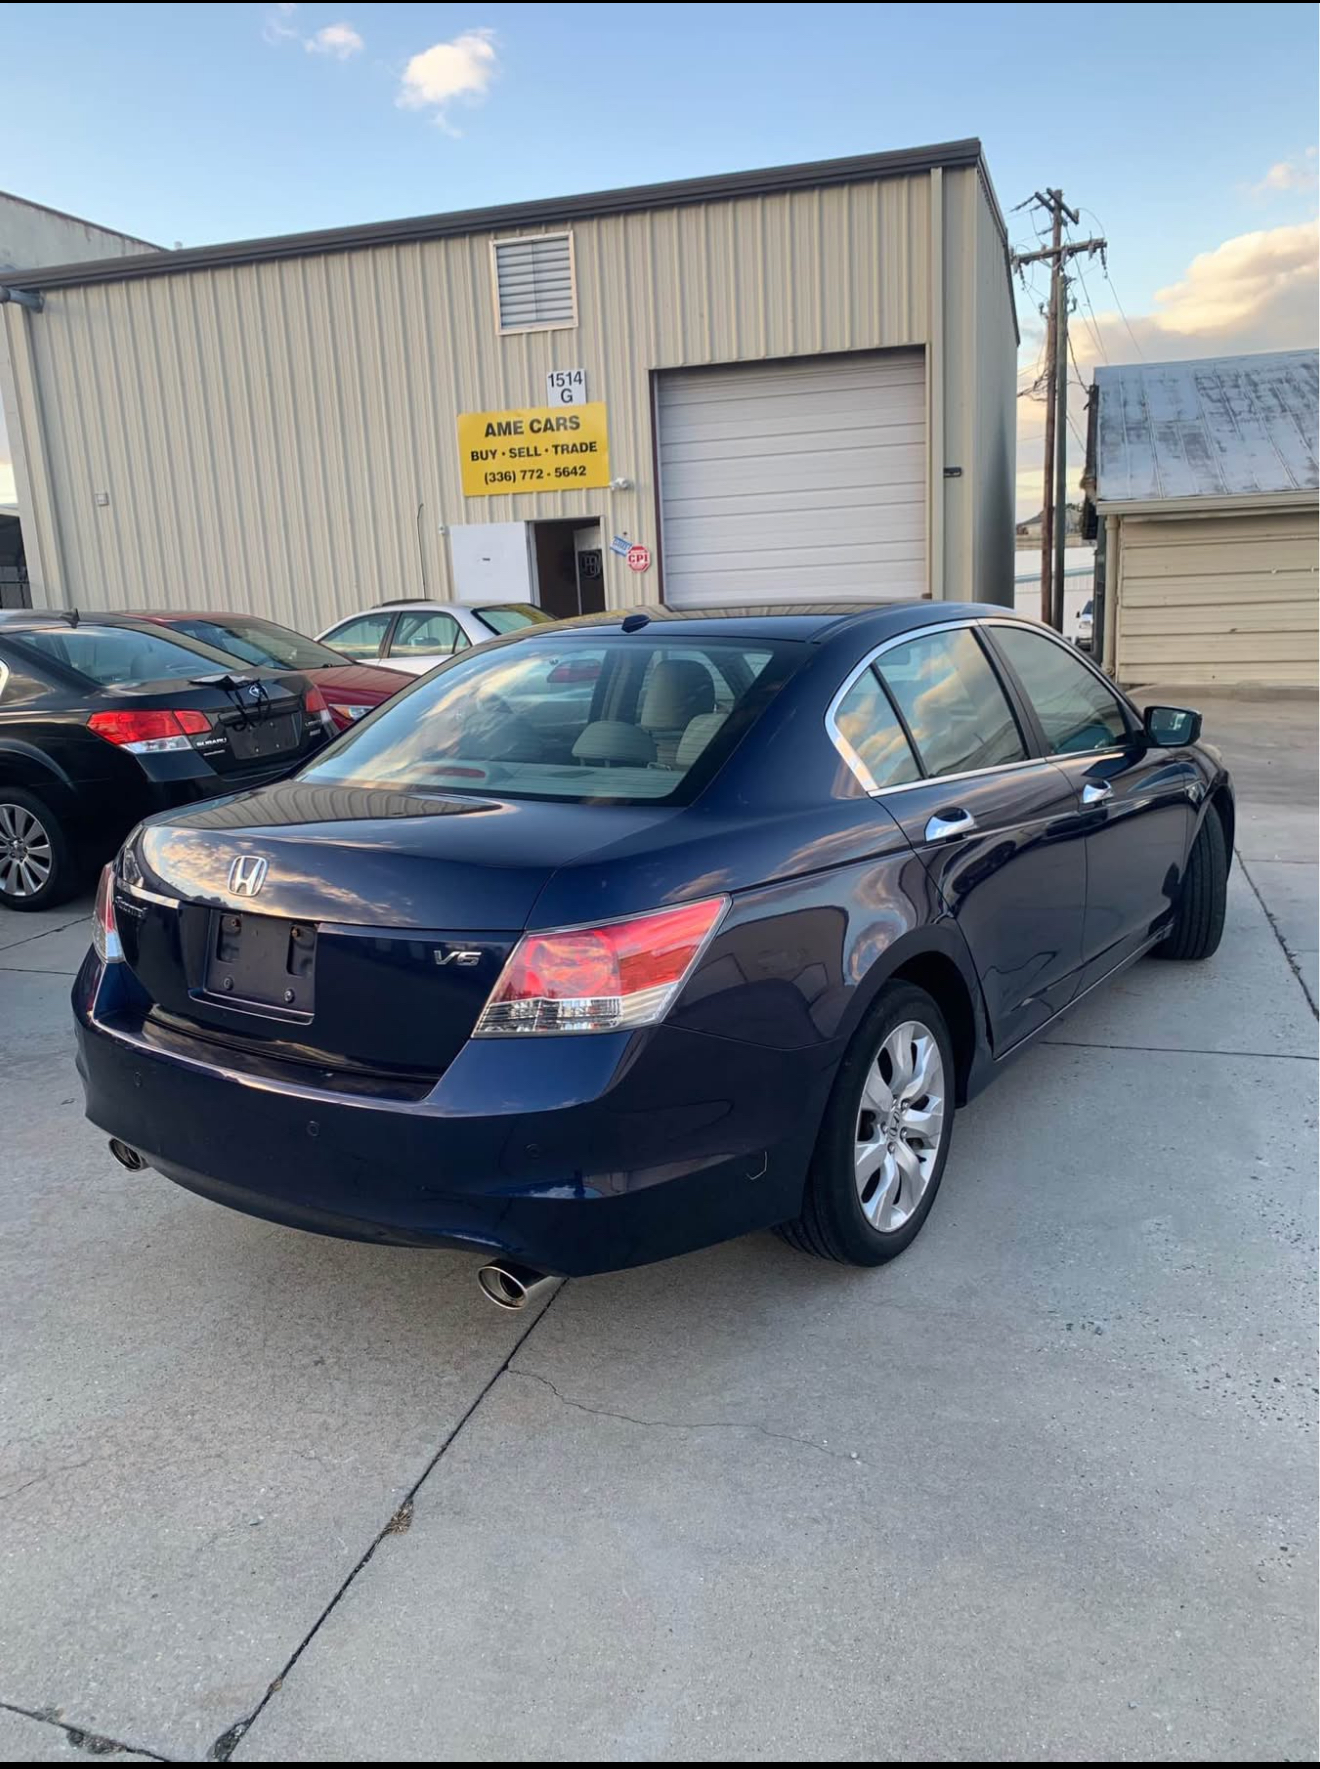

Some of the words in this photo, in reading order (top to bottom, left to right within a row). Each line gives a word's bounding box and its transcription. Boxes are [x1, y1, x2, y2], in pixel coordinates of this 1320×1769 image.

[548, 371, 583, 388] 1514
[560, 388, 573, 404] G
[484, 420, 525, 438] AME
[529, 415, 581, 434] CARS
[470, 449, 498, 462] BUY
[508, 446, 542, 459] SELL
[551, 441, 598, 455] TRADE
[484, 470, 516, 485] (336)
[519, 468, 544, 480] 772
[554, 465, 587, 478] 5642
[628, 554, 648, 563] CPI
[433, 950, 482, 966] V6
